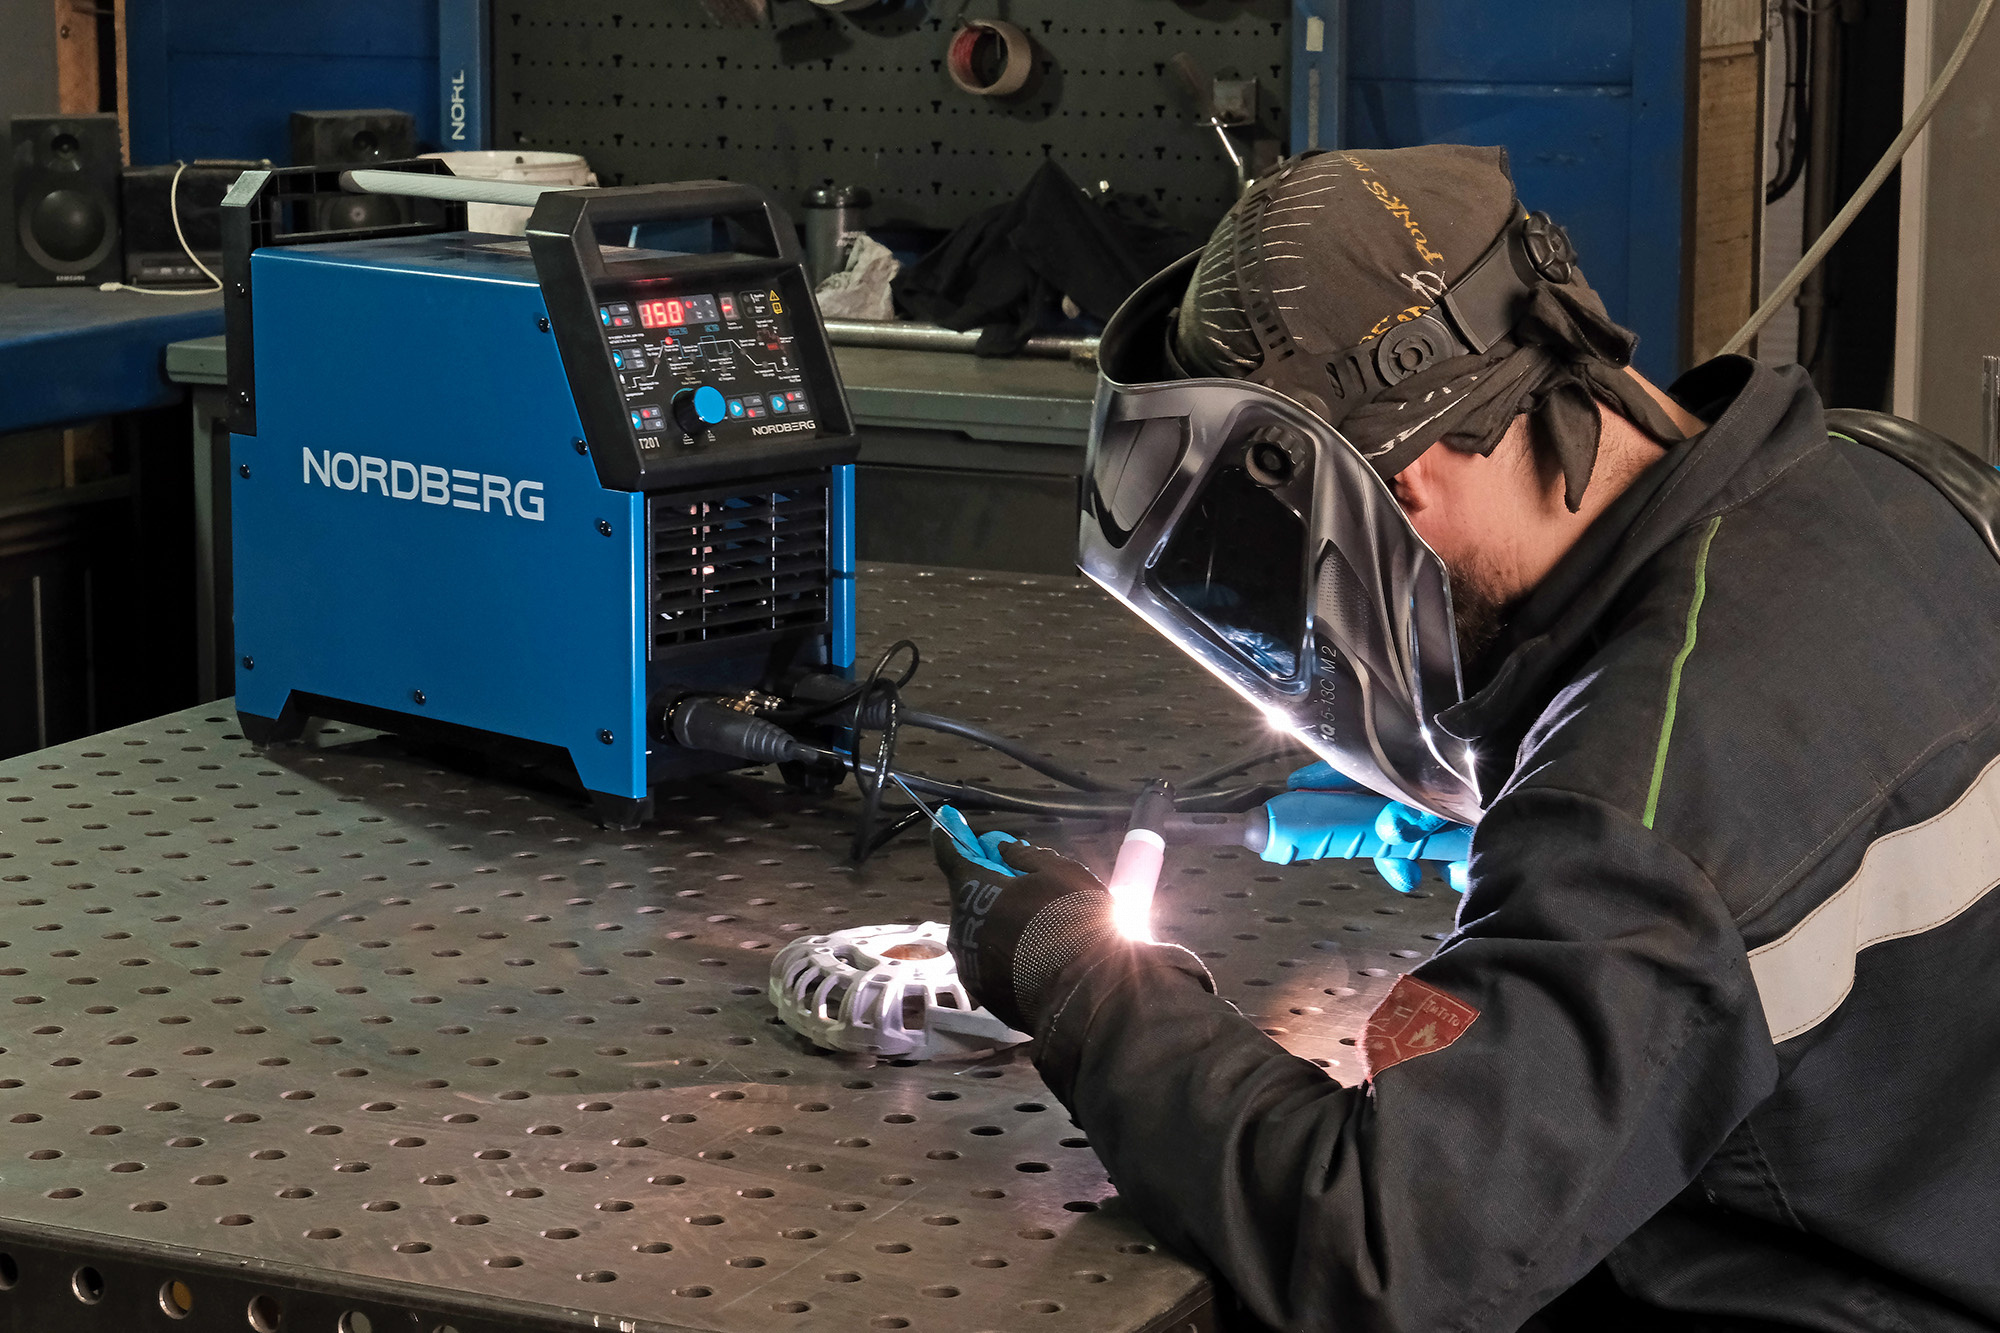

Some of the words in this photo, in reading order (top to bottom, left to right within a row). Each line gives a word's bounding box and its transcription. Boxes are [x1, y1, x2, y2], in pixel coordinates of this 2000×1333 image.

[644, 300, 684, 327] 150
[751, 420, 816, 436] NORDBERG
[638, 436, 660, 450] T201
[302, 446, 545, 522] NORDBERG
